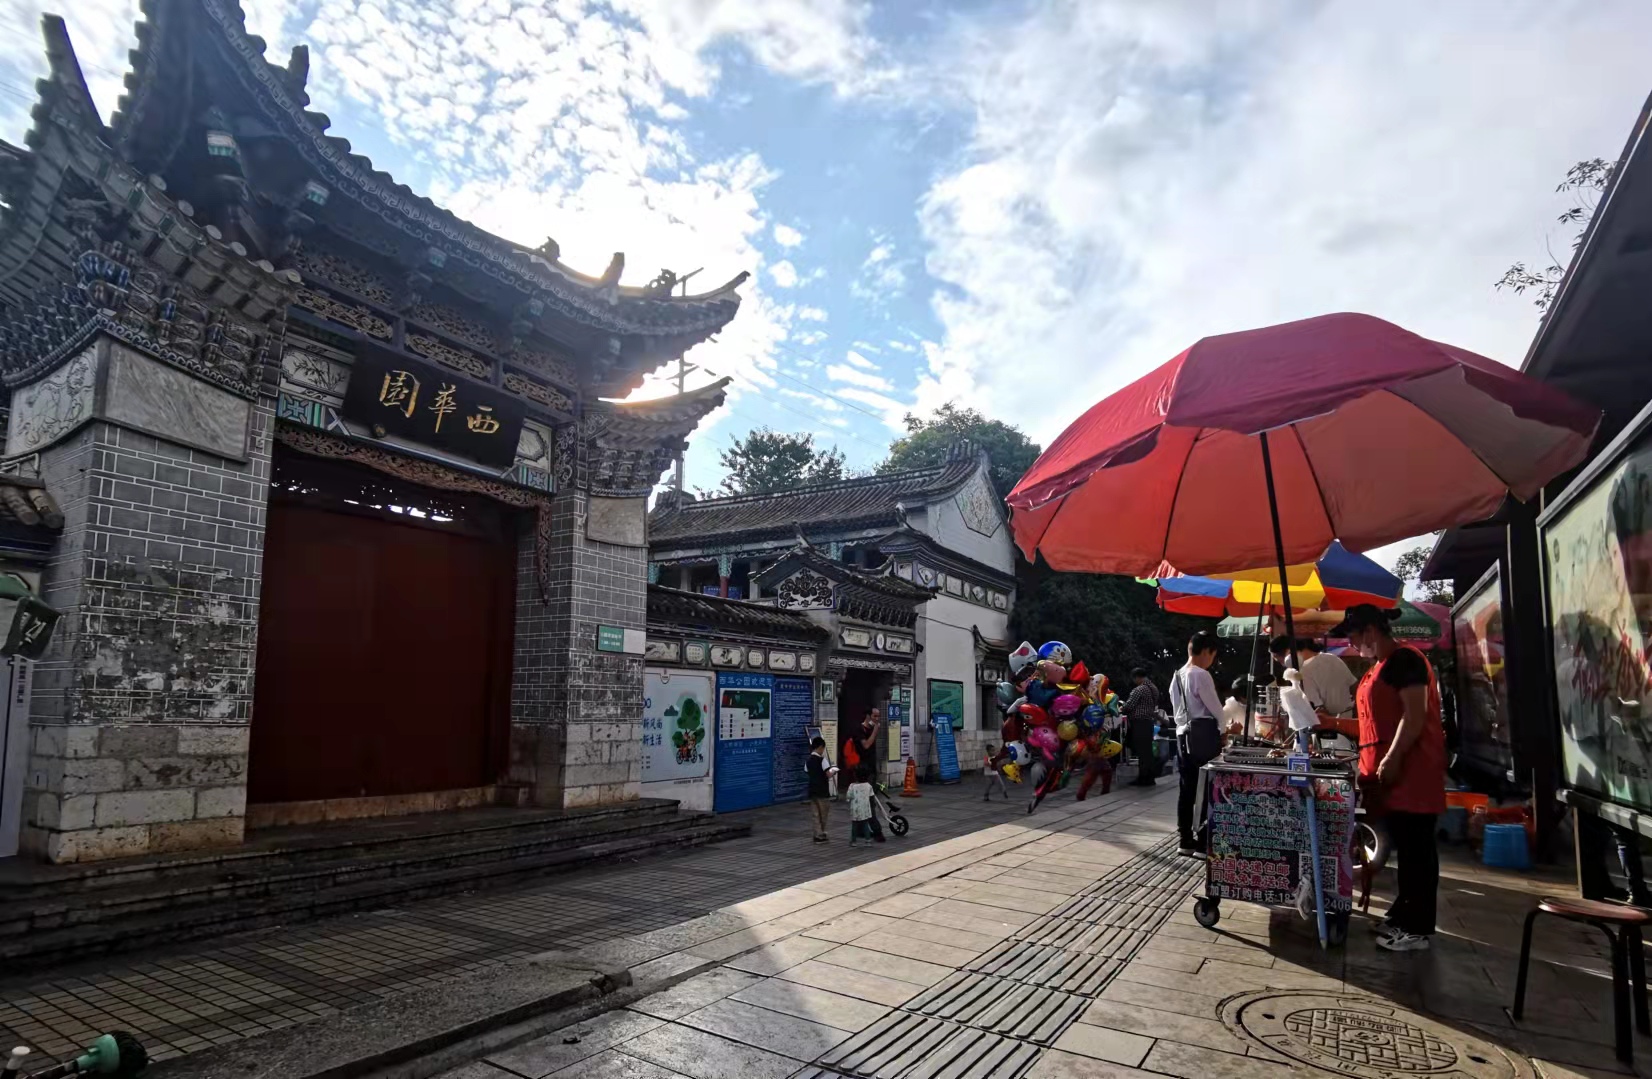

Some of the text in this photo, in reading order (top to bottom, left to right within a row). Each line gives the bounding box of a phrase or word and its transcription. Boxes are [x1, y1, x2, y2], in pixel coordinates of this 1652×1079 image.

[379, 369, 500, 434] 西華園
[1211, 859, 1290, 876] 全国快递包邮
[1211, 870, 1290, 889] 同城免费送货
[1324, 898, 1352, 911] 2406
